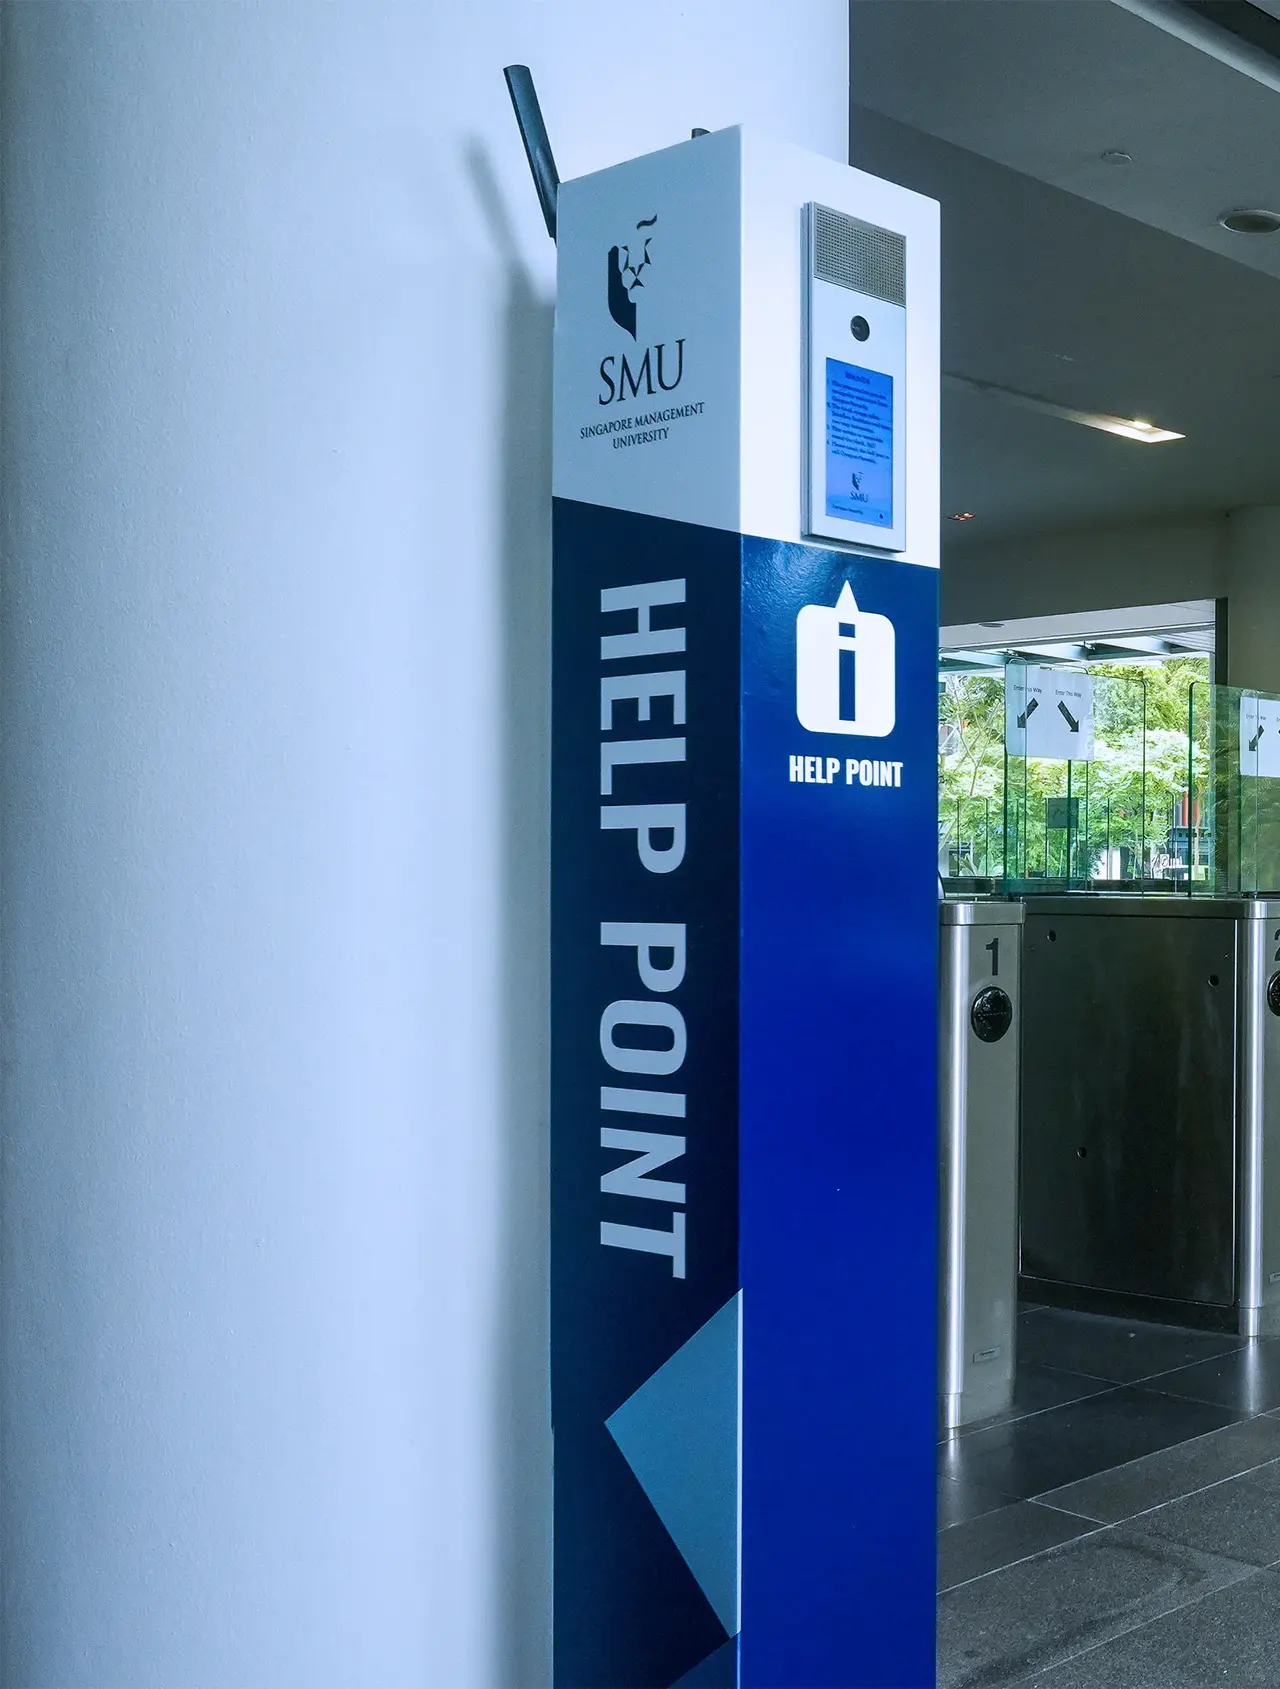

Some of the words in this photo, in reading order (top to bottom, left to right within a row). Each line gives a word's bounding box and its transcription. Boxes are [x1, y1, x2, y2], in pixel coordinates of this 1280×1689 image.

[598, 338, 686, 406] SMU
[580, 418, 633, 440] SINGAPORE
[634, 401, 705, 429] MANAGEMENT
[612, 427, 669, 450] UNIVERSITY
[600, 578, 686, 874] HELP
[789, 755, 840, 784] HELP
[846, 759, 903, 787] POINT
[985, 937, 999, 976] 1
[600, 921, 686, 1278] POINT
